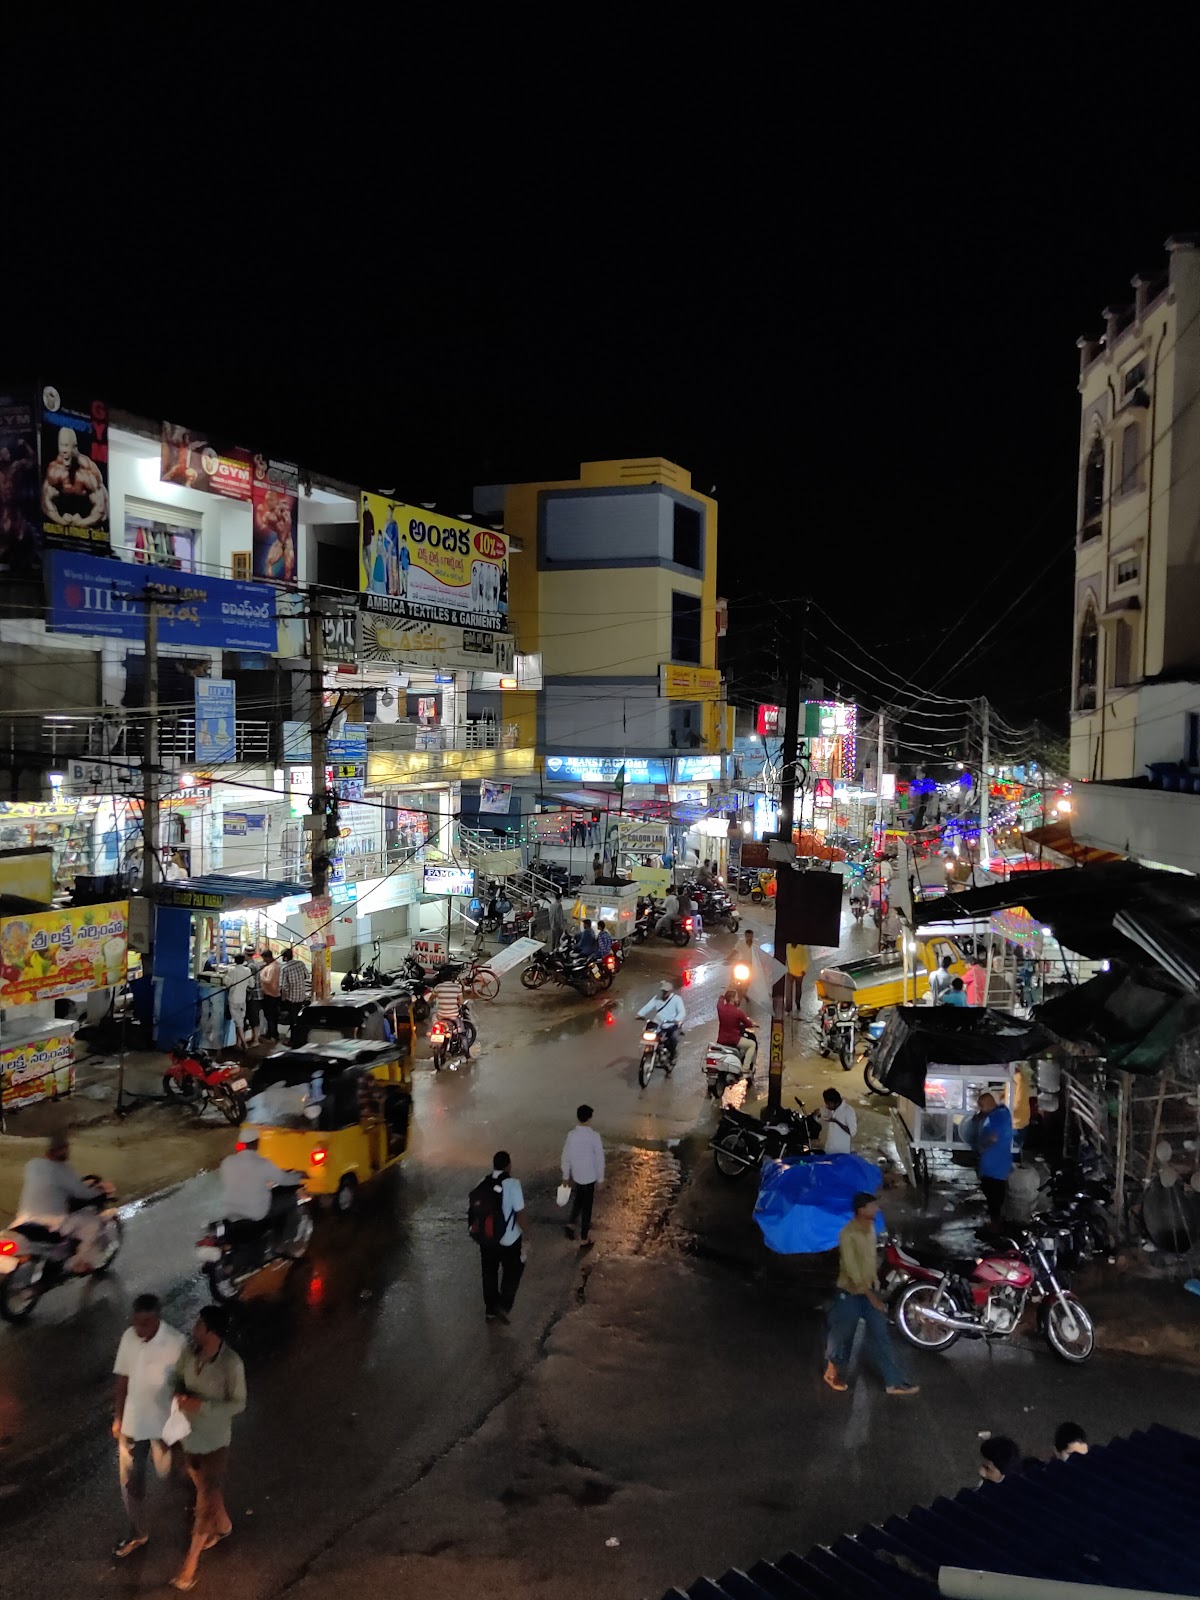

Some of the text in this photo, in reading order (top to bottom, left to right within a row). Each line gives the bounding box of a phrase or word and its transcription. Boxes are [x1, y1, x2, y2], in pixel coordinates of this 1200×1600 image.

[218, 464, 250, 481] GYM
[409, 519, 471, 556] అంబిక
[367, 595, 406, 615] AMBICA
[407, 602, 450, 622] TEXTILES
[451, 612, 459, 623] &
[460, 613, 502, 630] GARMENTS
[393, 751, 477, 772] AMBICA
